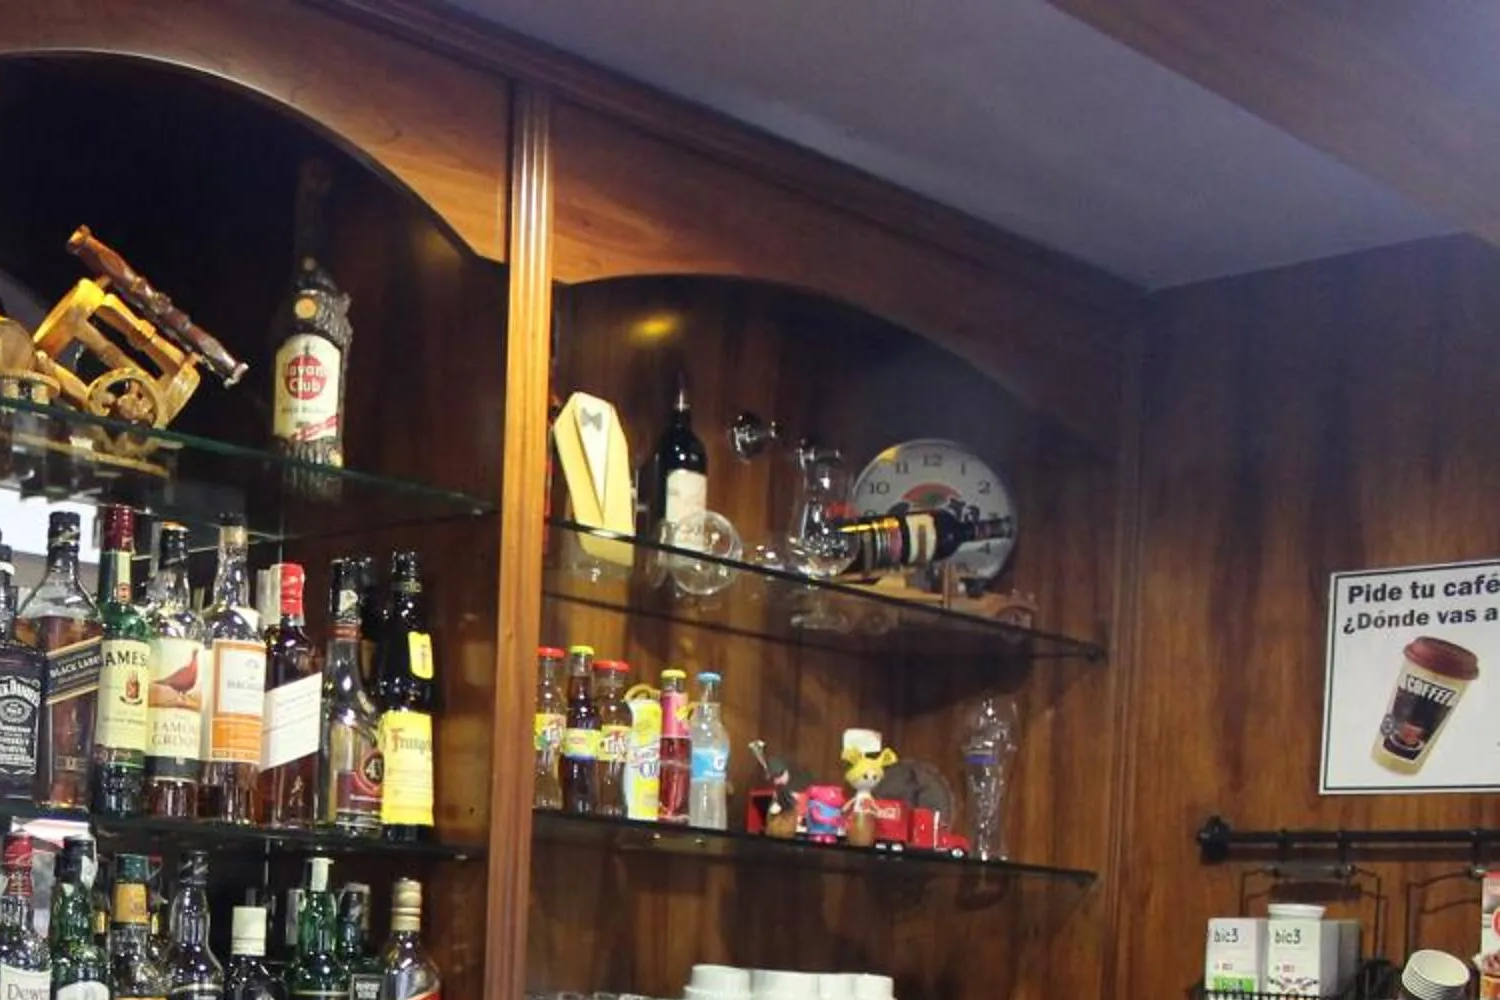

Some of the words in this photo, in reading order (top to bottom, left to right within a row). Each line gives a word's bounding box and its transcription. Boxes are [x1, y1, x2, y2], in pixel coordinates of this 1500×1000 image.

[922, 454, 943, 467] 12
[869, 481, 890, 495] 10
[1347, 583, 1403, 605] Pide
[1411, 580, 1435, 599] tu
[1442, 572, 1500, 597] café
[1342, 609, 1430, 635] ¿Dónde
[1437, 608, 1477, 625] vas
[1484, 607, 1499, 621] a
